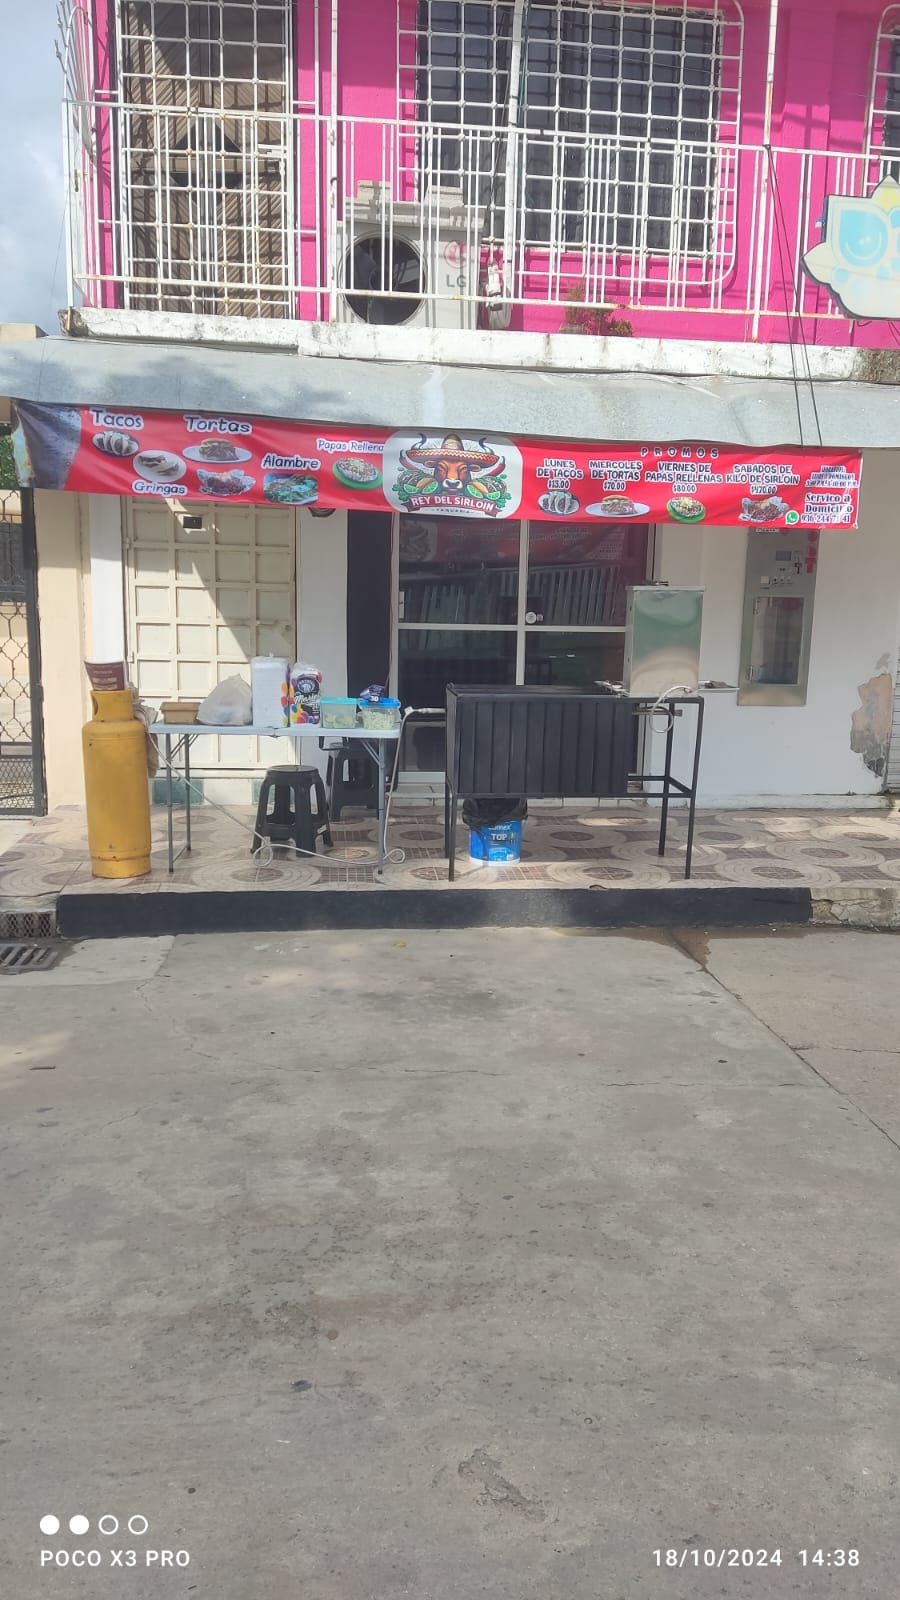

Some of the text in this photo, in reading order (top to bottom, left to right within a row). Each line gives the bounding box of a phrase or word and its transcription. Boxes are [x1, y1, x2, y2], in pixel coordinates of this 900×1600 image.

[446, 273, 467, 288] LG
[91, 408, 143, 429] Tacos
[185, 416, 250, 433] Tortas
[317, 439, 347, 453] Papas
[641, 447, 719, 458] PROMOS
[262, 454, 319, 469] Alambre
[544, 459, 575, 469] LUNES
[590, 461, 642, 470] MIERCOLES
[537, 468, 583, 478] DE TACOS
[658, 462, 711, 473] VIERNES DE
[734, 465, 791, 474] SABADOS DE
[592, 470, 640, 480] DE TORTAS
[645, 472, 722, 483] PAPAS RELLENAS
[726, 474, 748, 483] KILO
[750, 475, 763, 483] DE
[764, 475, 799, 485] SIRLOIN
[134, 481, 187, 495] Gringas
[411, 495, 495, 511] REY DEL SIRLOIN
[844, 495, 850, 503] a
[816, 514, 830, 522] 244
[491, 833, 508, 841] TOP
